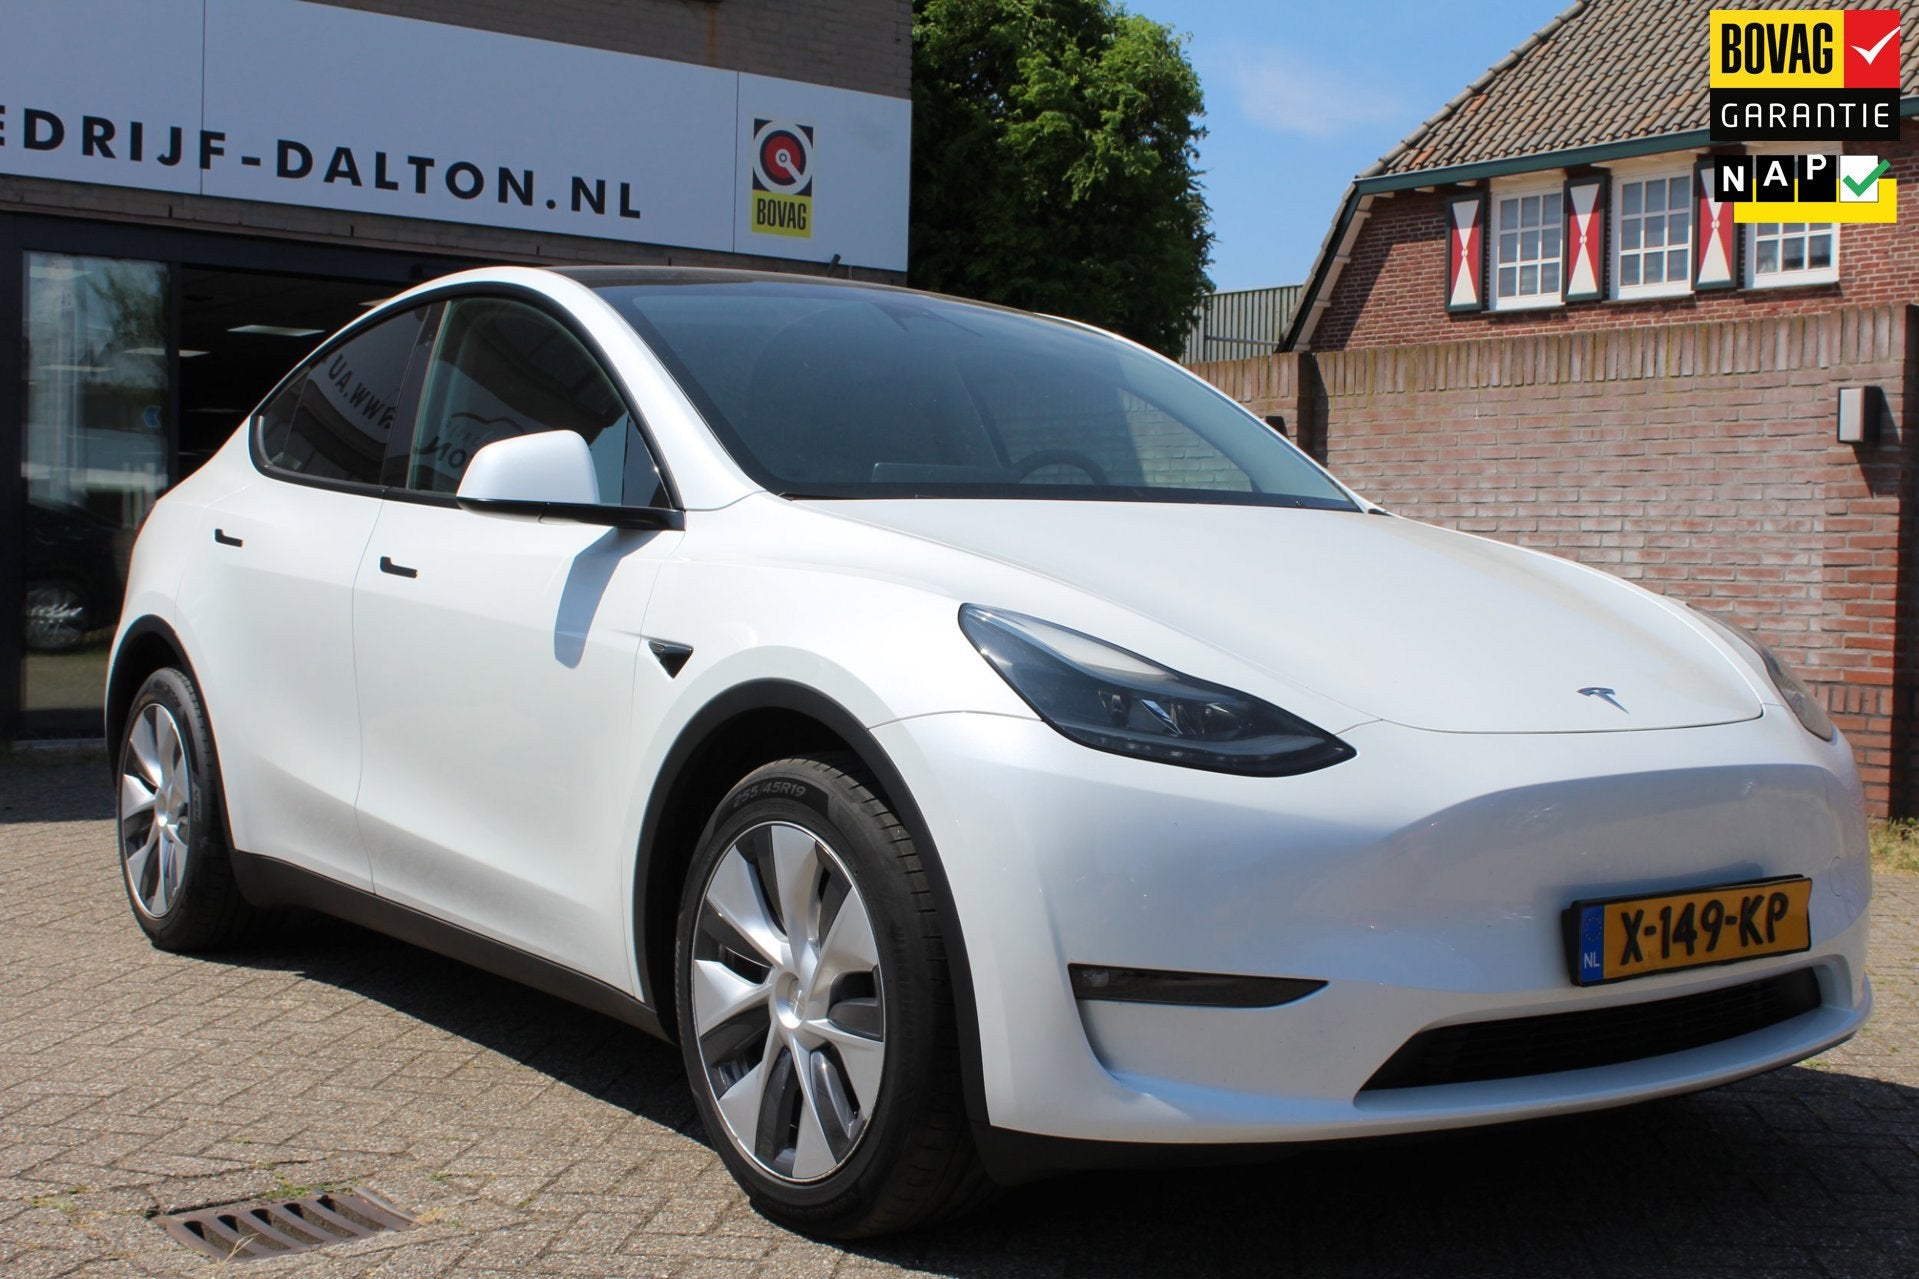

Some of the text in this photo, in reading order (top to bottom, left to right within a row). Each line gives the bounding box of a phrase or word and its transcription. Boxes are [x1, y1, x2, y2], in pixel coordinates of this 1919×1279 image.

[0, 104, 641, 219] DRIJF-DALTON.NL
[756, 198, 807, 231] BOVAG
[1583, 892, 1789, 969] NL X-149-KP
